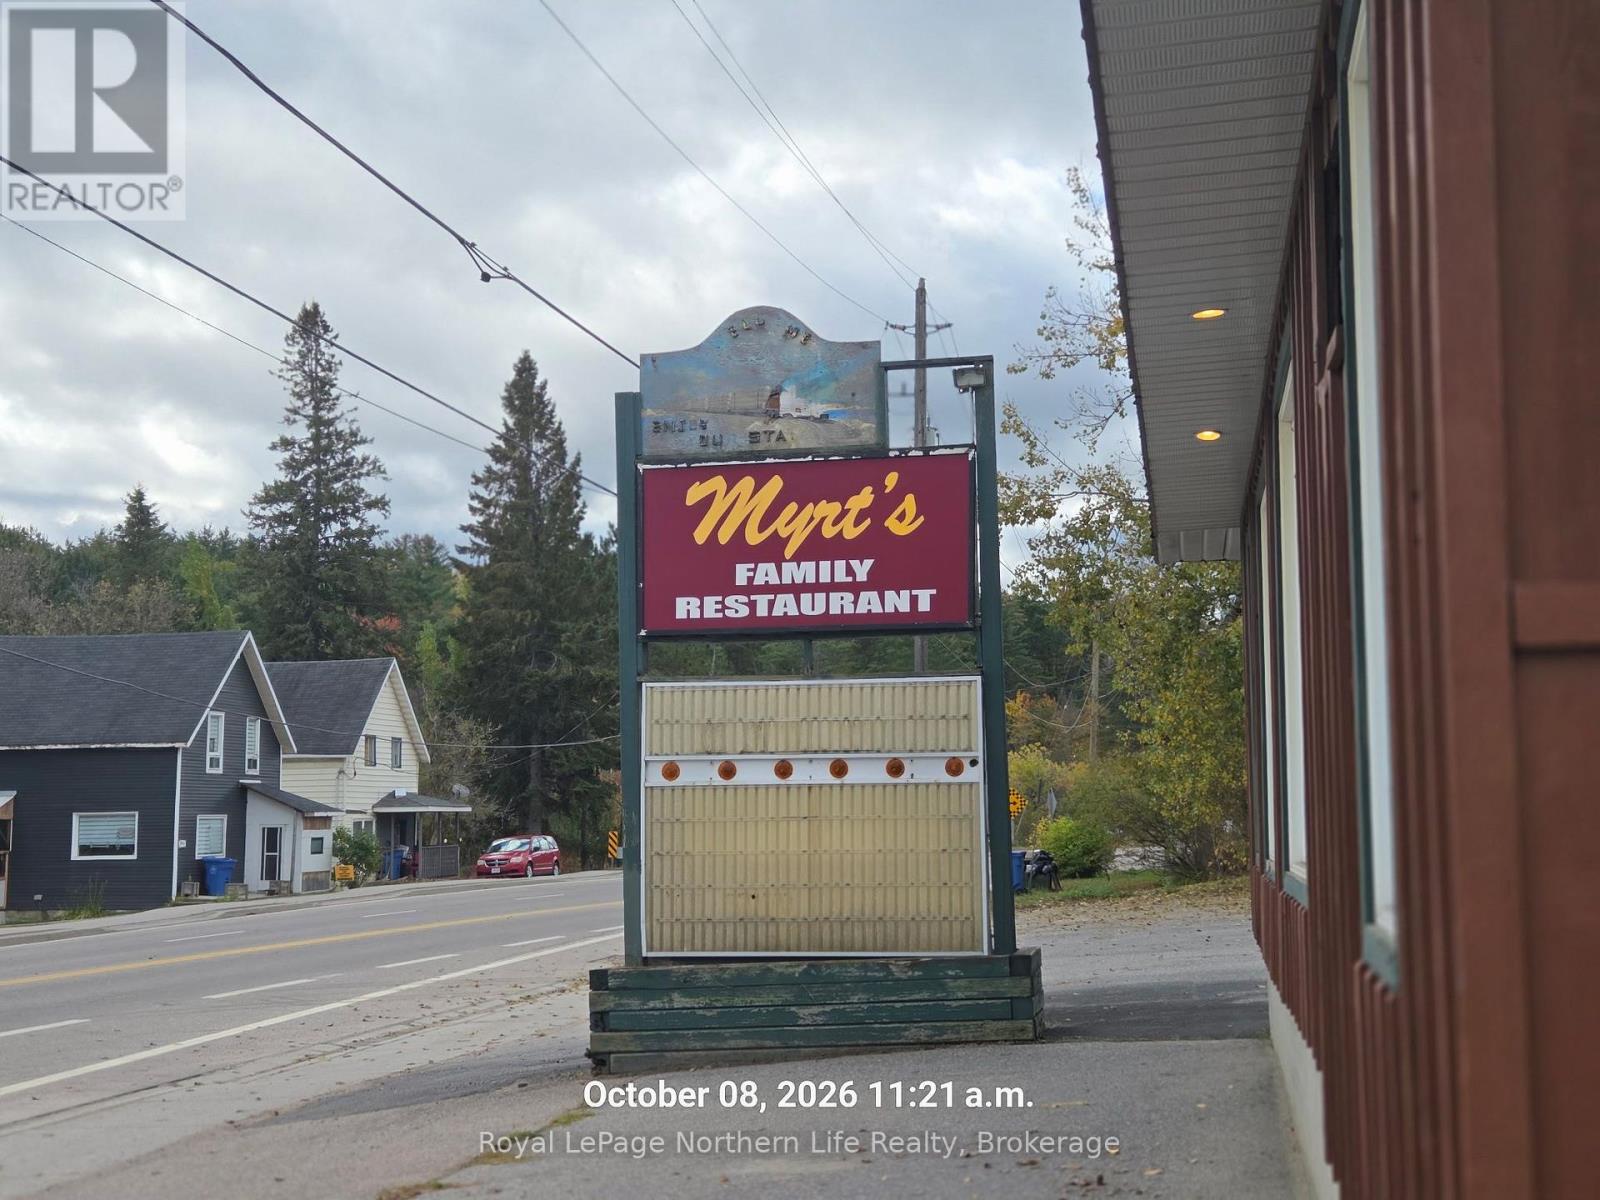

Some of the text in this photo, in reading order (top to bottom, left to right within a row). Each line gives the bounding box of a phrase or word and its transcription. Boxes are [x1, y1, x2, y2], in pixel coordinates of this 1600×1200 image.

[685, 471, 925, 560] Myrt's
[735, 558, 875, 586] FAMILY
[675, 588, 937, 619] RESTAURANT
